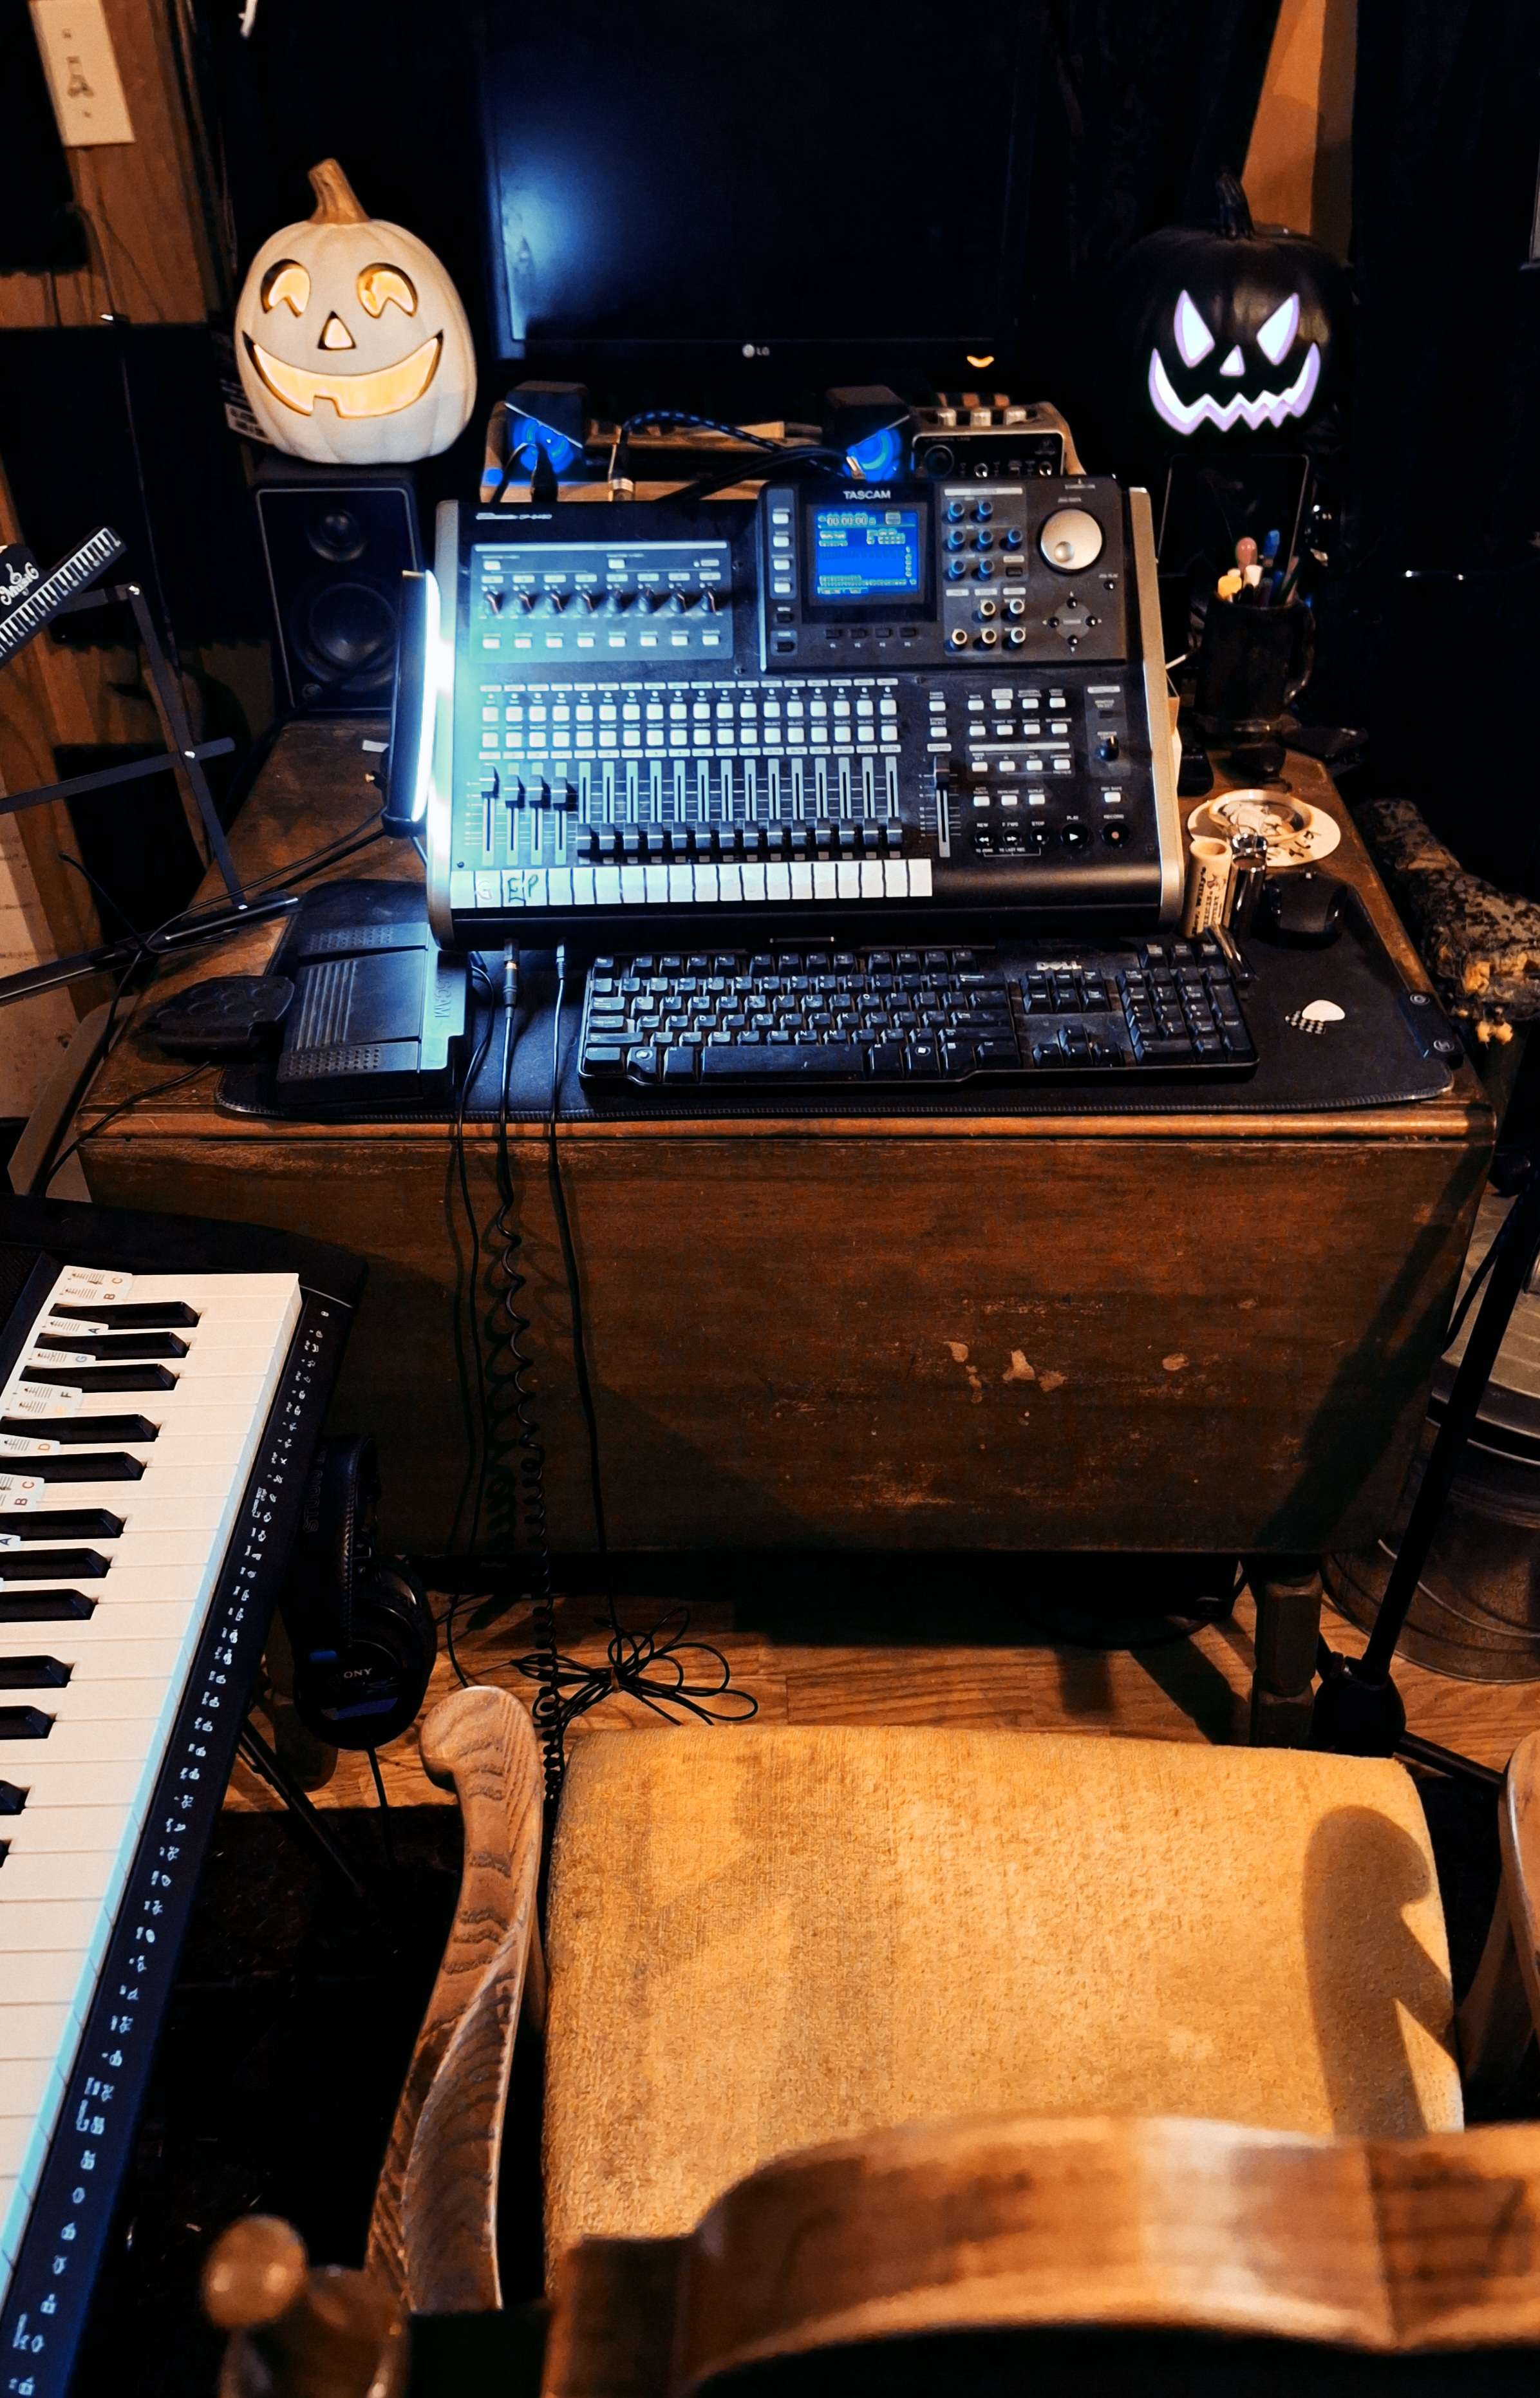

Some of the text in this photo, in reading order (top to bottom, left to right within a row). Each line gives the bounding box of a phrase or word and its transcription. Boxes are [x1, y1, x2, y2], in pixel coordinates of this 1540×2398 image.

[843, 490, 891, 500] TASCAM
[37, 1443, 51, 1451] D
[22, 1481, 35, 1489] C
[14, 1498, 28, 1506] B
[0, 1538, 12, 1546] A
[343, 1668, 372, 1679] ONY
